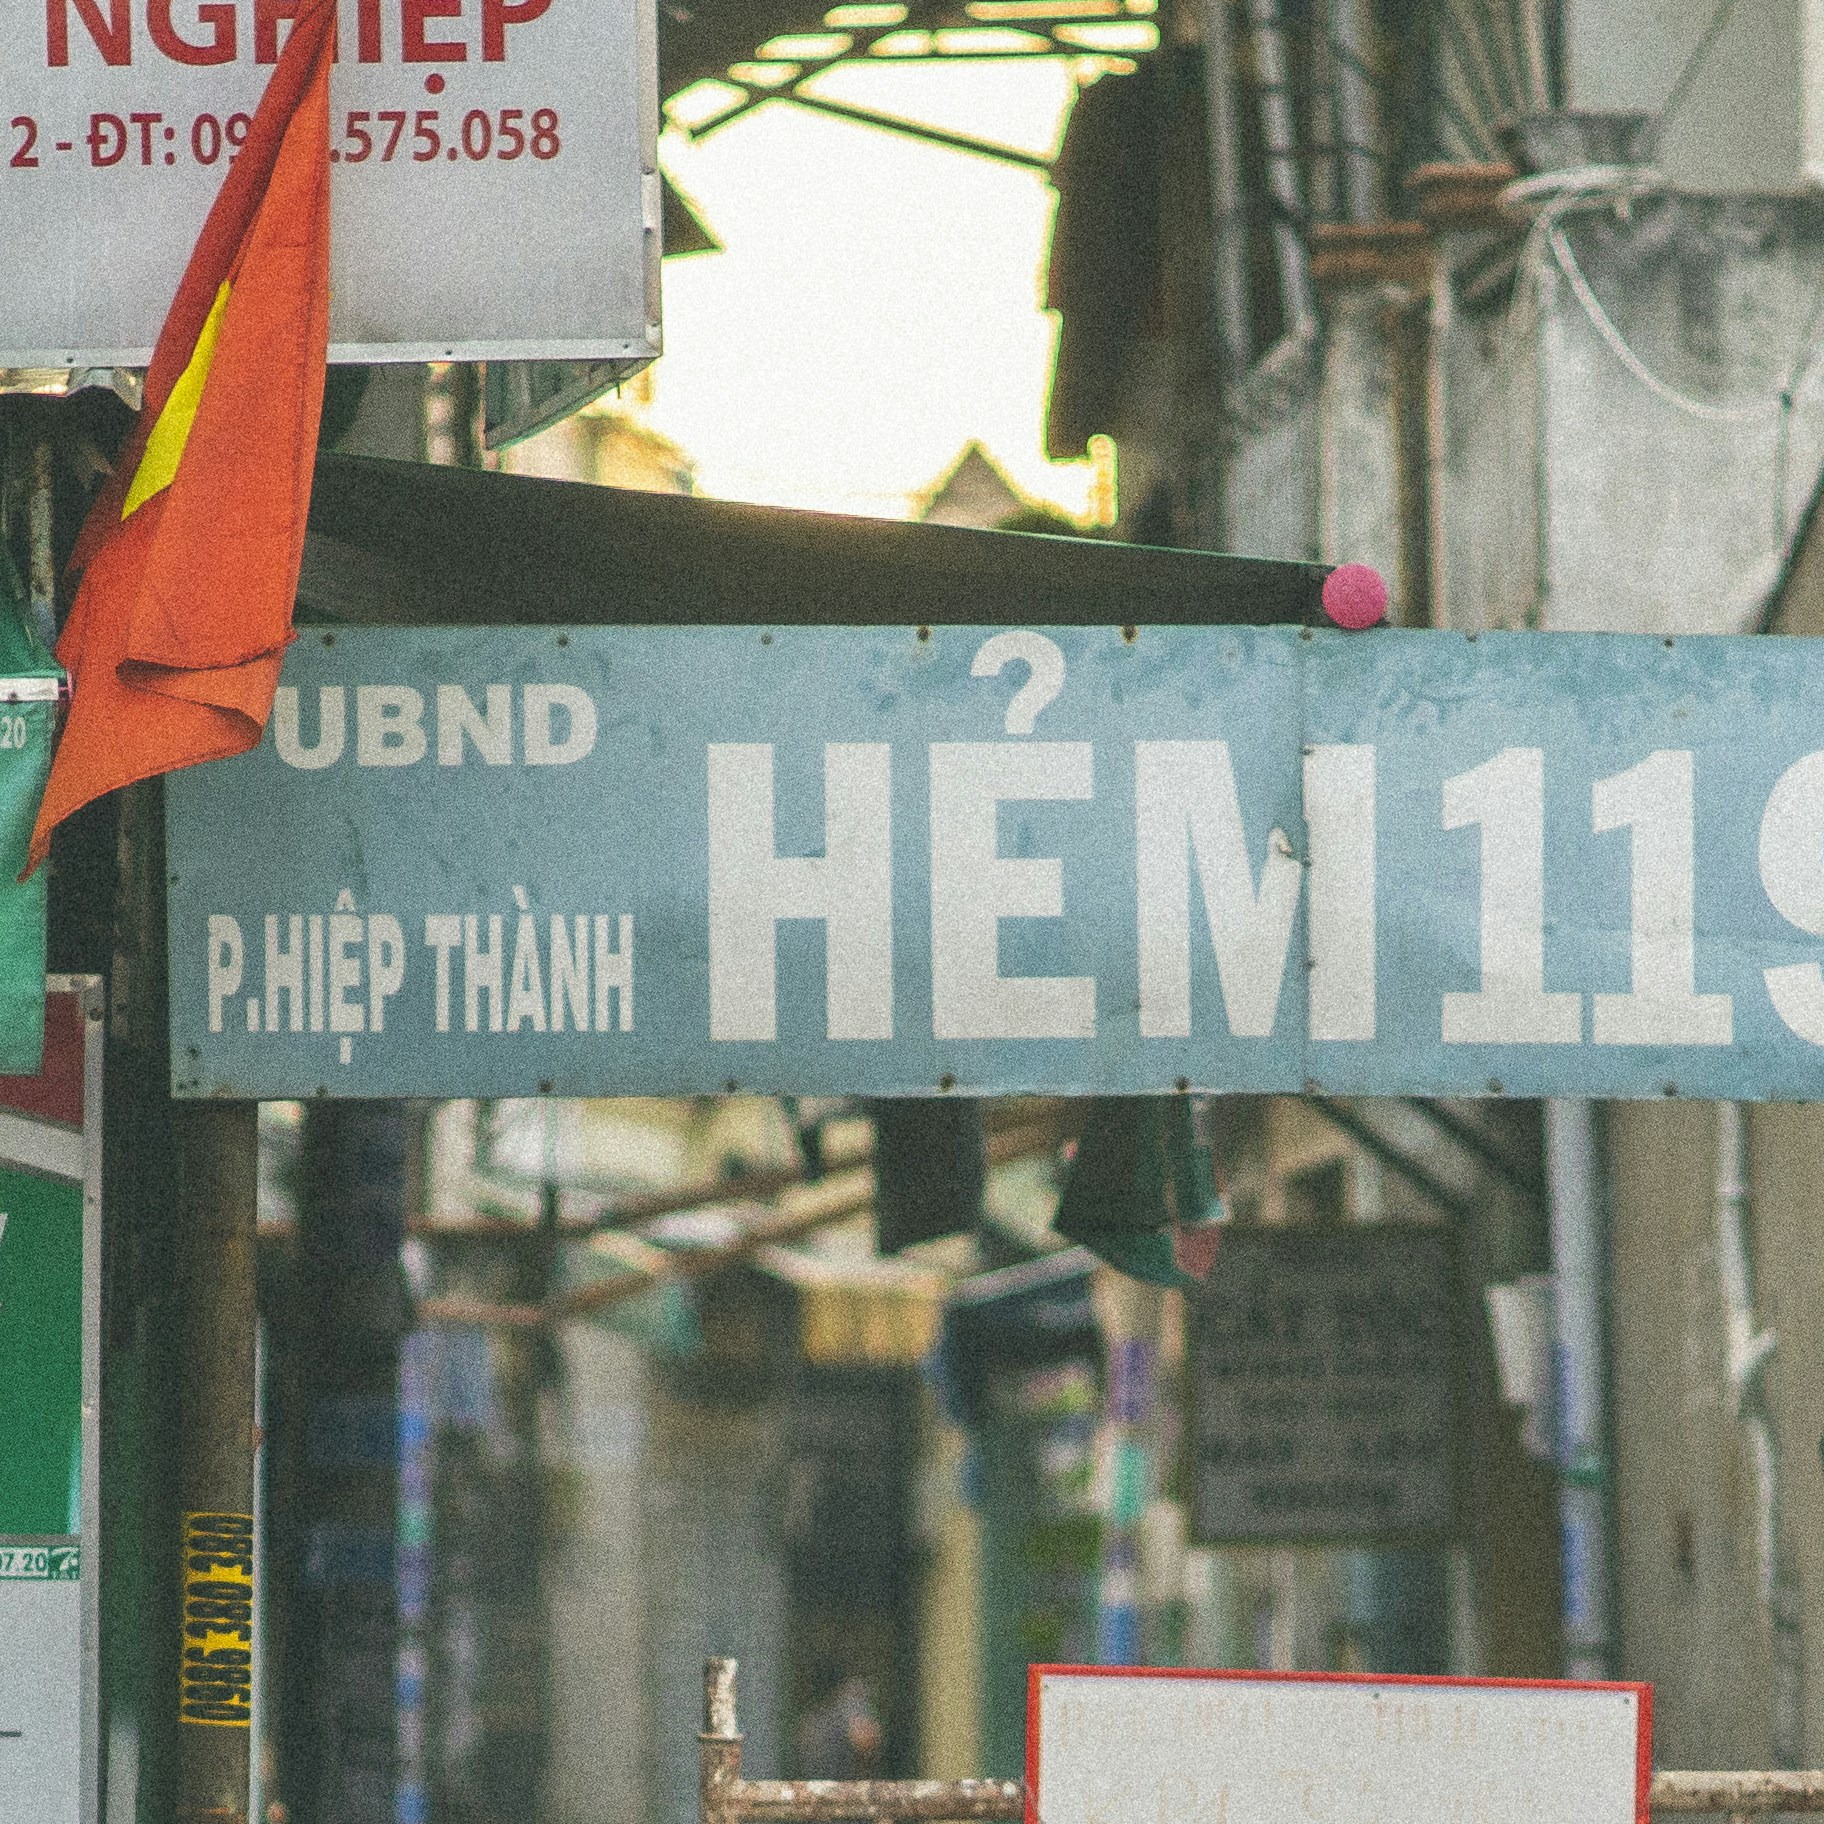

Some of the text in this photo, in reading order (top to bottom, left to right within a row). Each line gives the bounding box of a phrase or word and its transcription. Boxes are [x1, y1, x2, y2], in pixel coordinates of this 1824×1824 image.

[87, 112, 177, 168] ĐT:
[274, 683, 599, 769] UBND
[707, 630, 1376, 1042] HẺM
[207, 885, 635, 1065] P.HIỆP THÀNH
